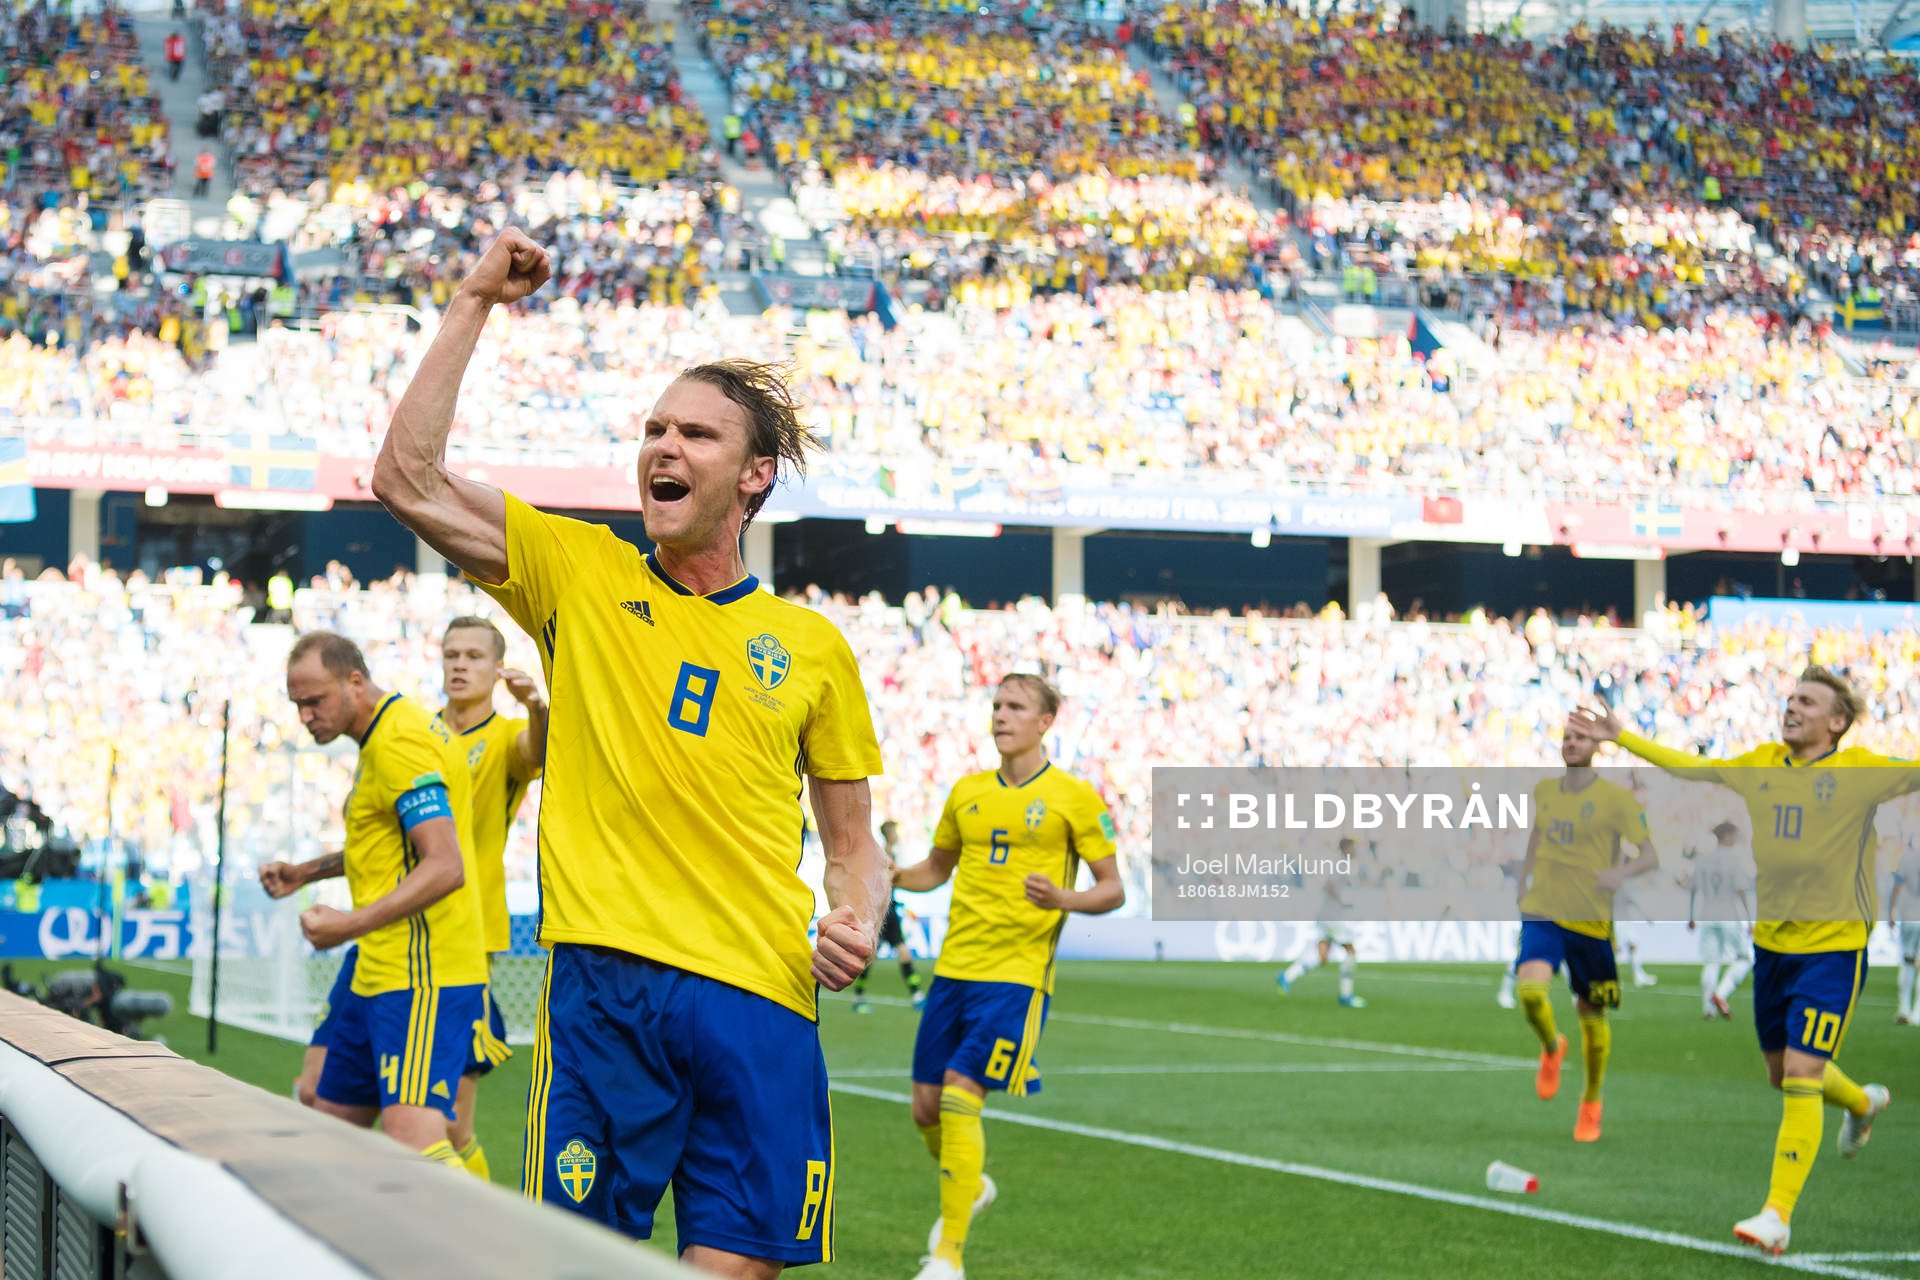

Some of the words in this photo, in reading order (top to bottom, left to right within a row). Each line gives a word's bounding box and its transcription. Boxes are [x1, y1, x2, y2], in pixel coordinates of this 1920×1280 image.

[620, 601, 655, 627] adidas
[667, 661, 721, 738] 8
[1548, 819, 1575, 844] 20
[1771, 804, 1803, 840] 10
[989, 829, 1010, 865] 6
[1801, 1007, 1842, 1052] 10
[380, 1053, 399, 1094] 4
[984, 1037, 1016, 1081] 6
[795, 1159, 826, 1241] 8
